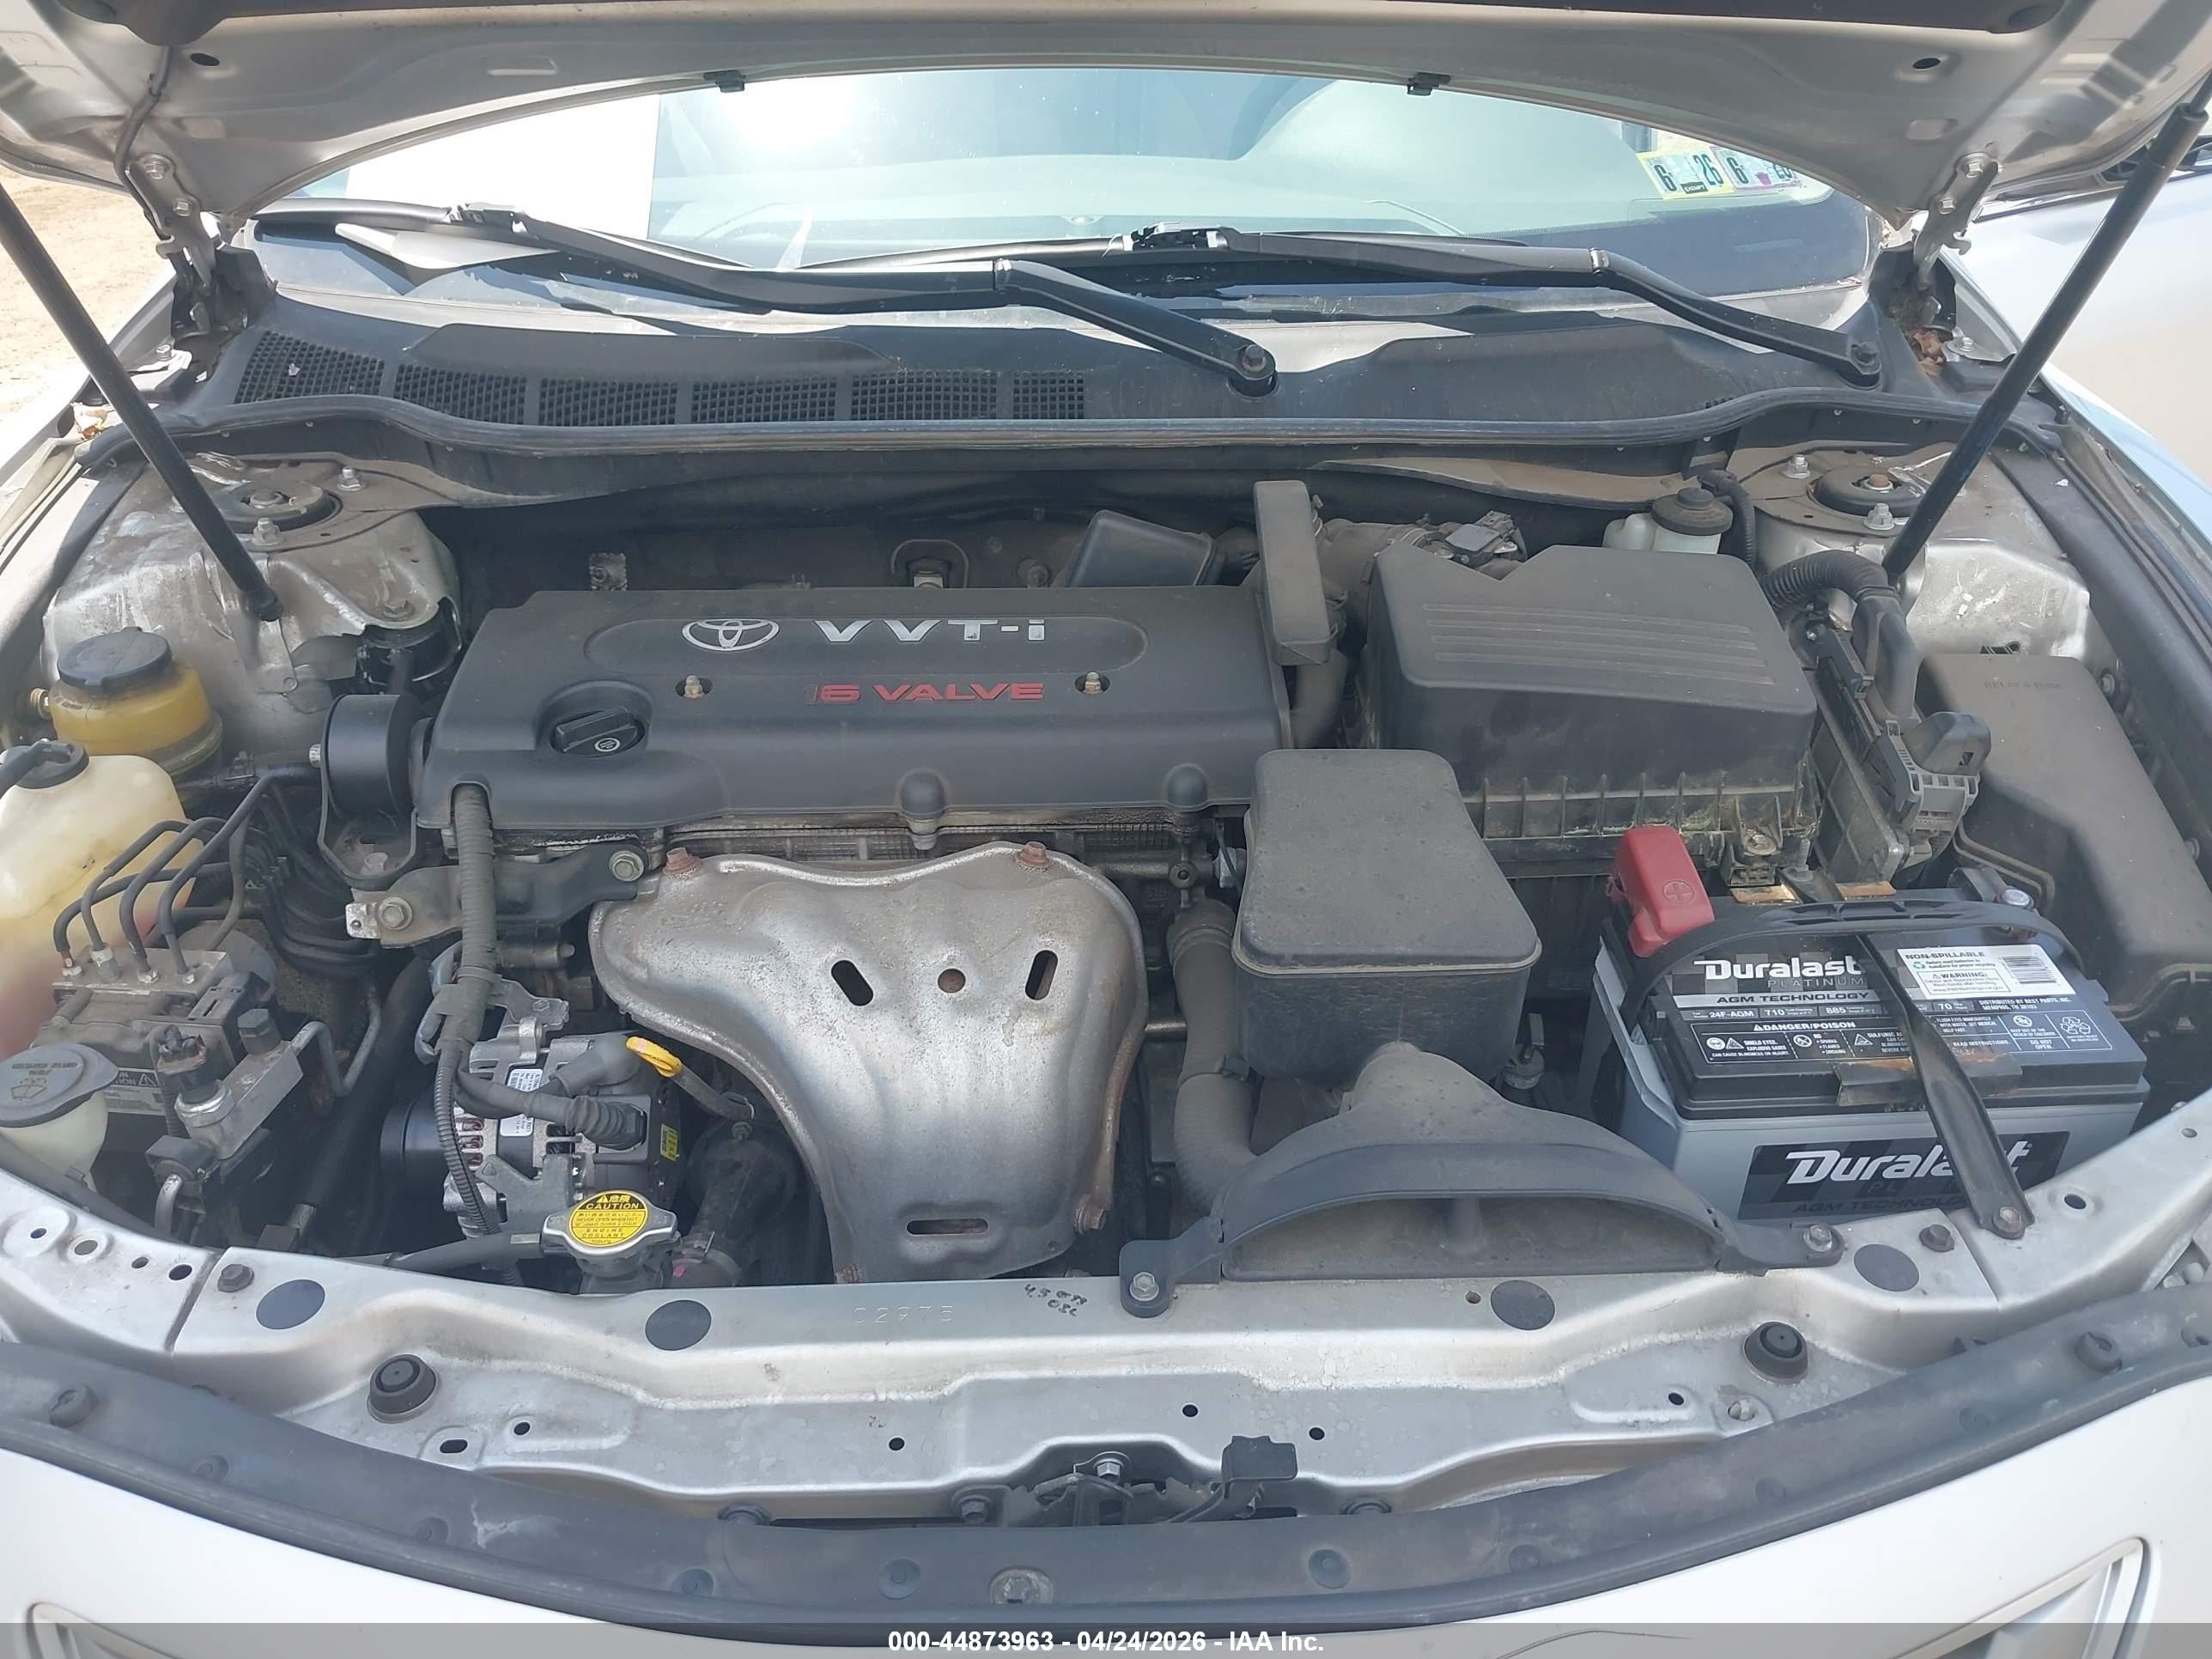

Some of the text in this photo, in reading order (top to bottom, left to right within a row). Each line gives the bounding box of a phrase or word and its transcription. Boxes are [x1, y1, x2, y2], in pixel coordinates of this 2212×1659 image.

[1692, 154, 1723, 185] 26
[1726, 157, 1748, 184] 6
[1654, 164, 1677, 191] 6
[872, 682, 1045, 702] VALVE
[1905, 951, 1986, 960] NON-SPILLABLE
[1693, 955, 1863, 980] Duralast
[1767, 977, 1865, 988] PLATINUM
[1717, 992, 1869, 1004] AGM TECHNOLOGY
[1709, 1010, 1754, 1019] 24F-AGM
[1764, 1008, 1785, 1017] 710
[1826, 1006, 1846, 1015] 885
[1763, 1021, 1856, 1031] DANGER/POISON
[1784, 1140, 2029, 1186] Duralt
